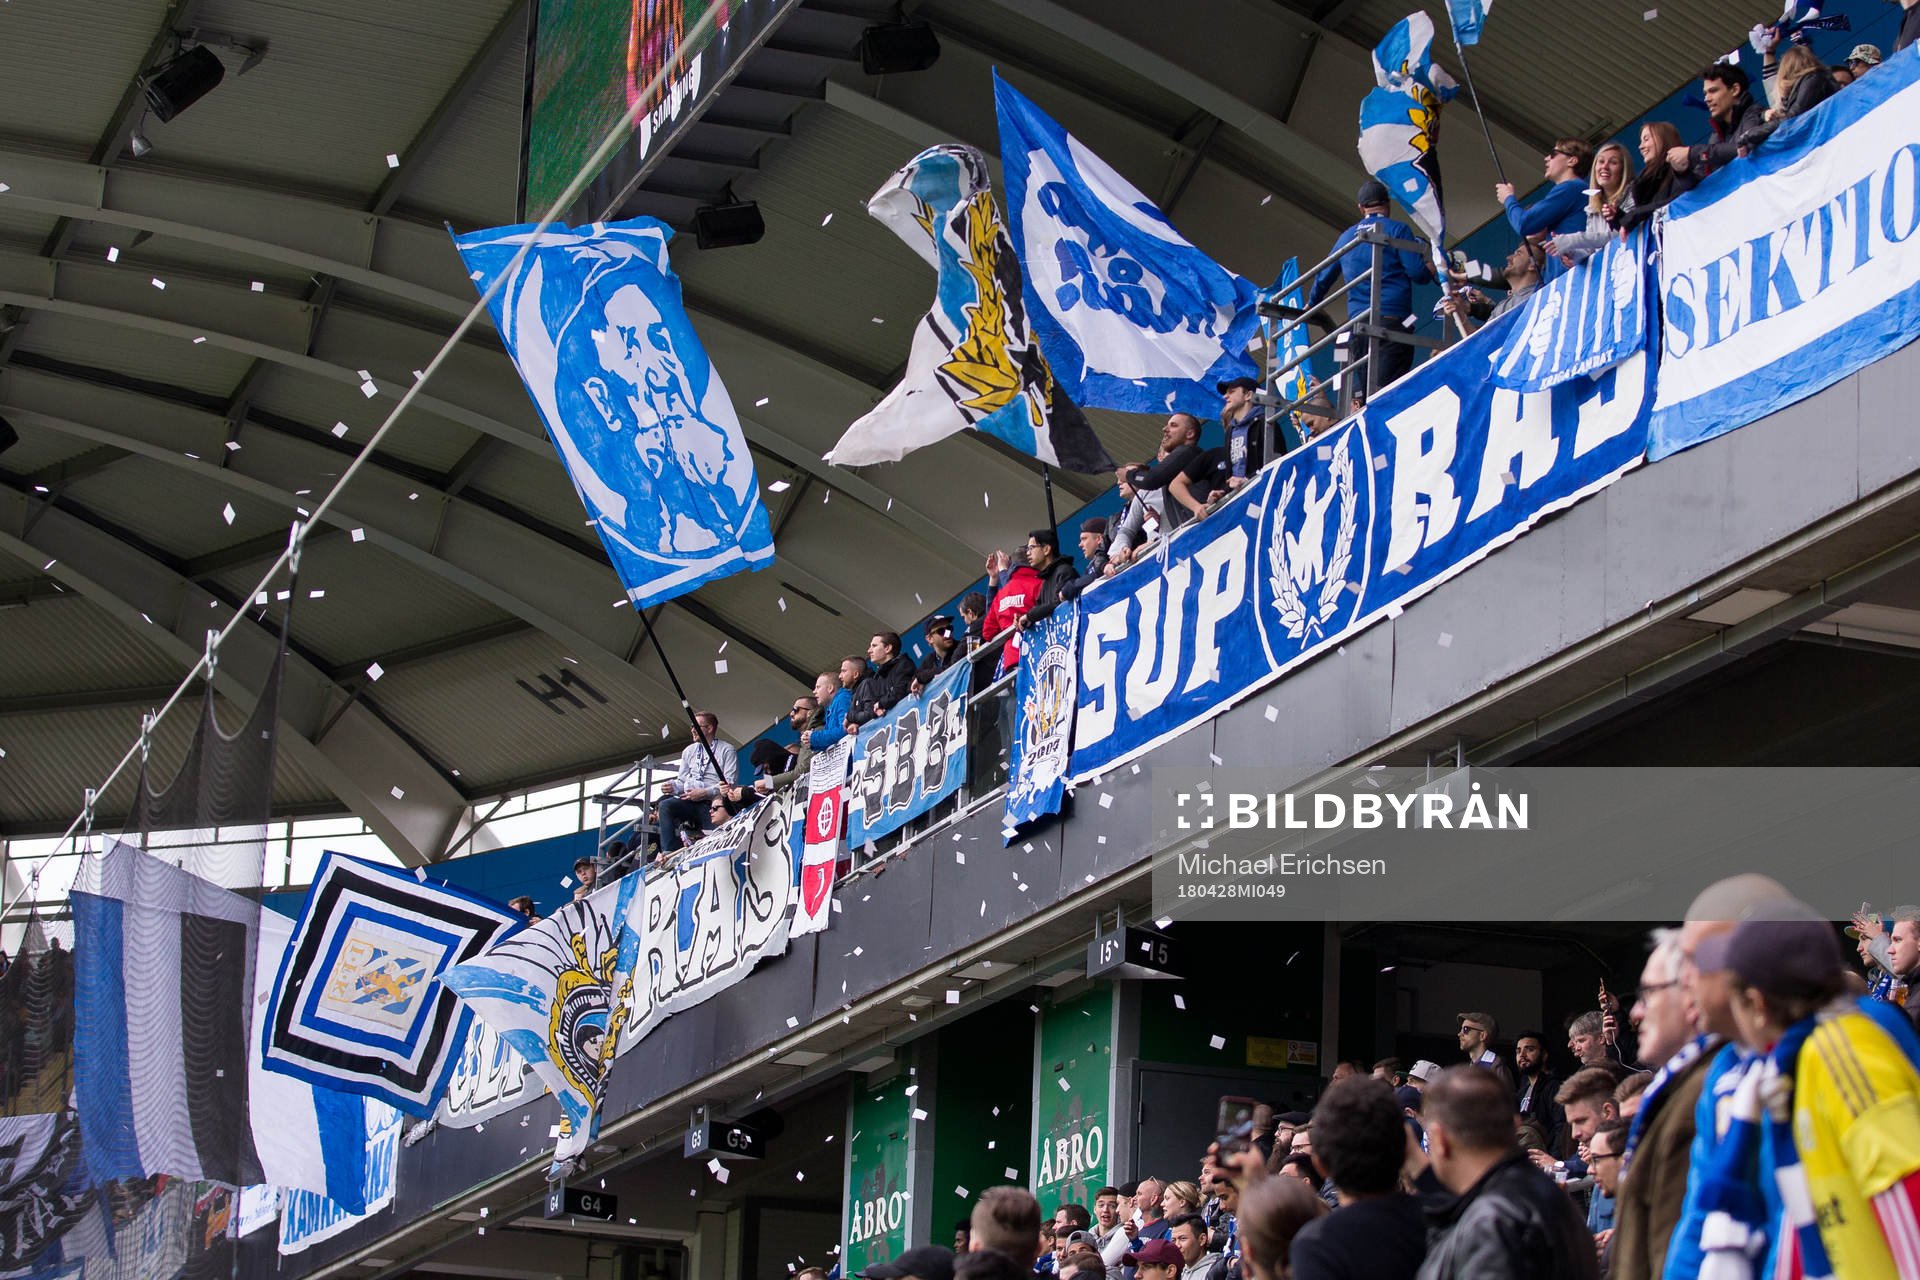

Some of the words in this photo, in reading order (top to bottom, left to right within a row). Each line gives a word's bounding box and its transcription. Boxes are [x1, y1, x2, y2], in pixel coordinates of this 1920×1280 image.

[1665, 143, 1920, 359] SEKTIO
[1075, 525, 1248, 751] SUP
[516, 667, 608, 715] H1
[863, 688, 952, 830] SBB
[691, 1130, 702, 1149] G5
[1037, 1125, 1103, 1188] ÅBRO
[550, 1196, 559, 1211] G4
[581, 1195, 602, 1213] G4
[849, 1190, 902, 1245] ÅBRO
